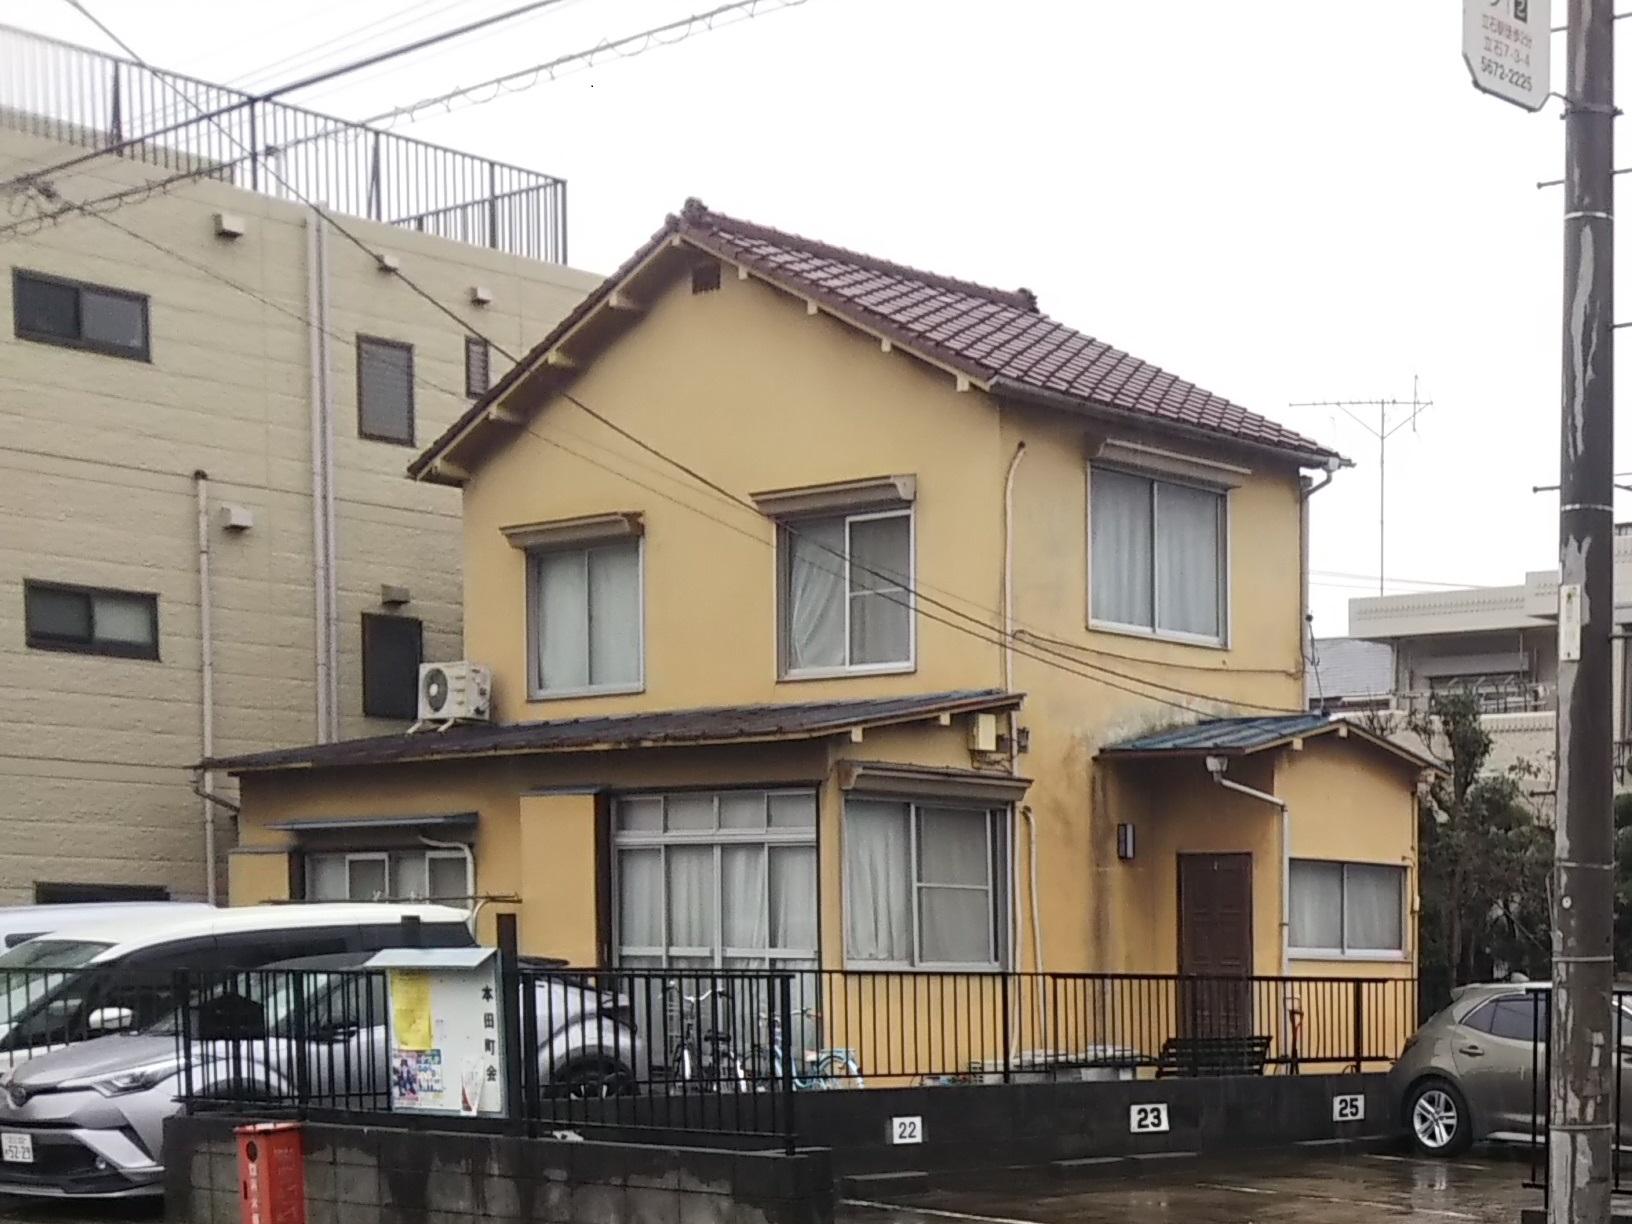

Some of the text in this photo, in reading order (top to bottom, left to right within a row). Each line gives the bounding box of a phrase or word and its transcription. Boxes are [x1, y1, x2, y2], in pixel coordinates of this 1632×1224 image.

[481, 985, 497, 1082] 本田町会
[1136, 1106, 1162, 1129] 23
[1338, 1097, 1360, 1117] 25
[898, 1121, 917, 1139] 22
